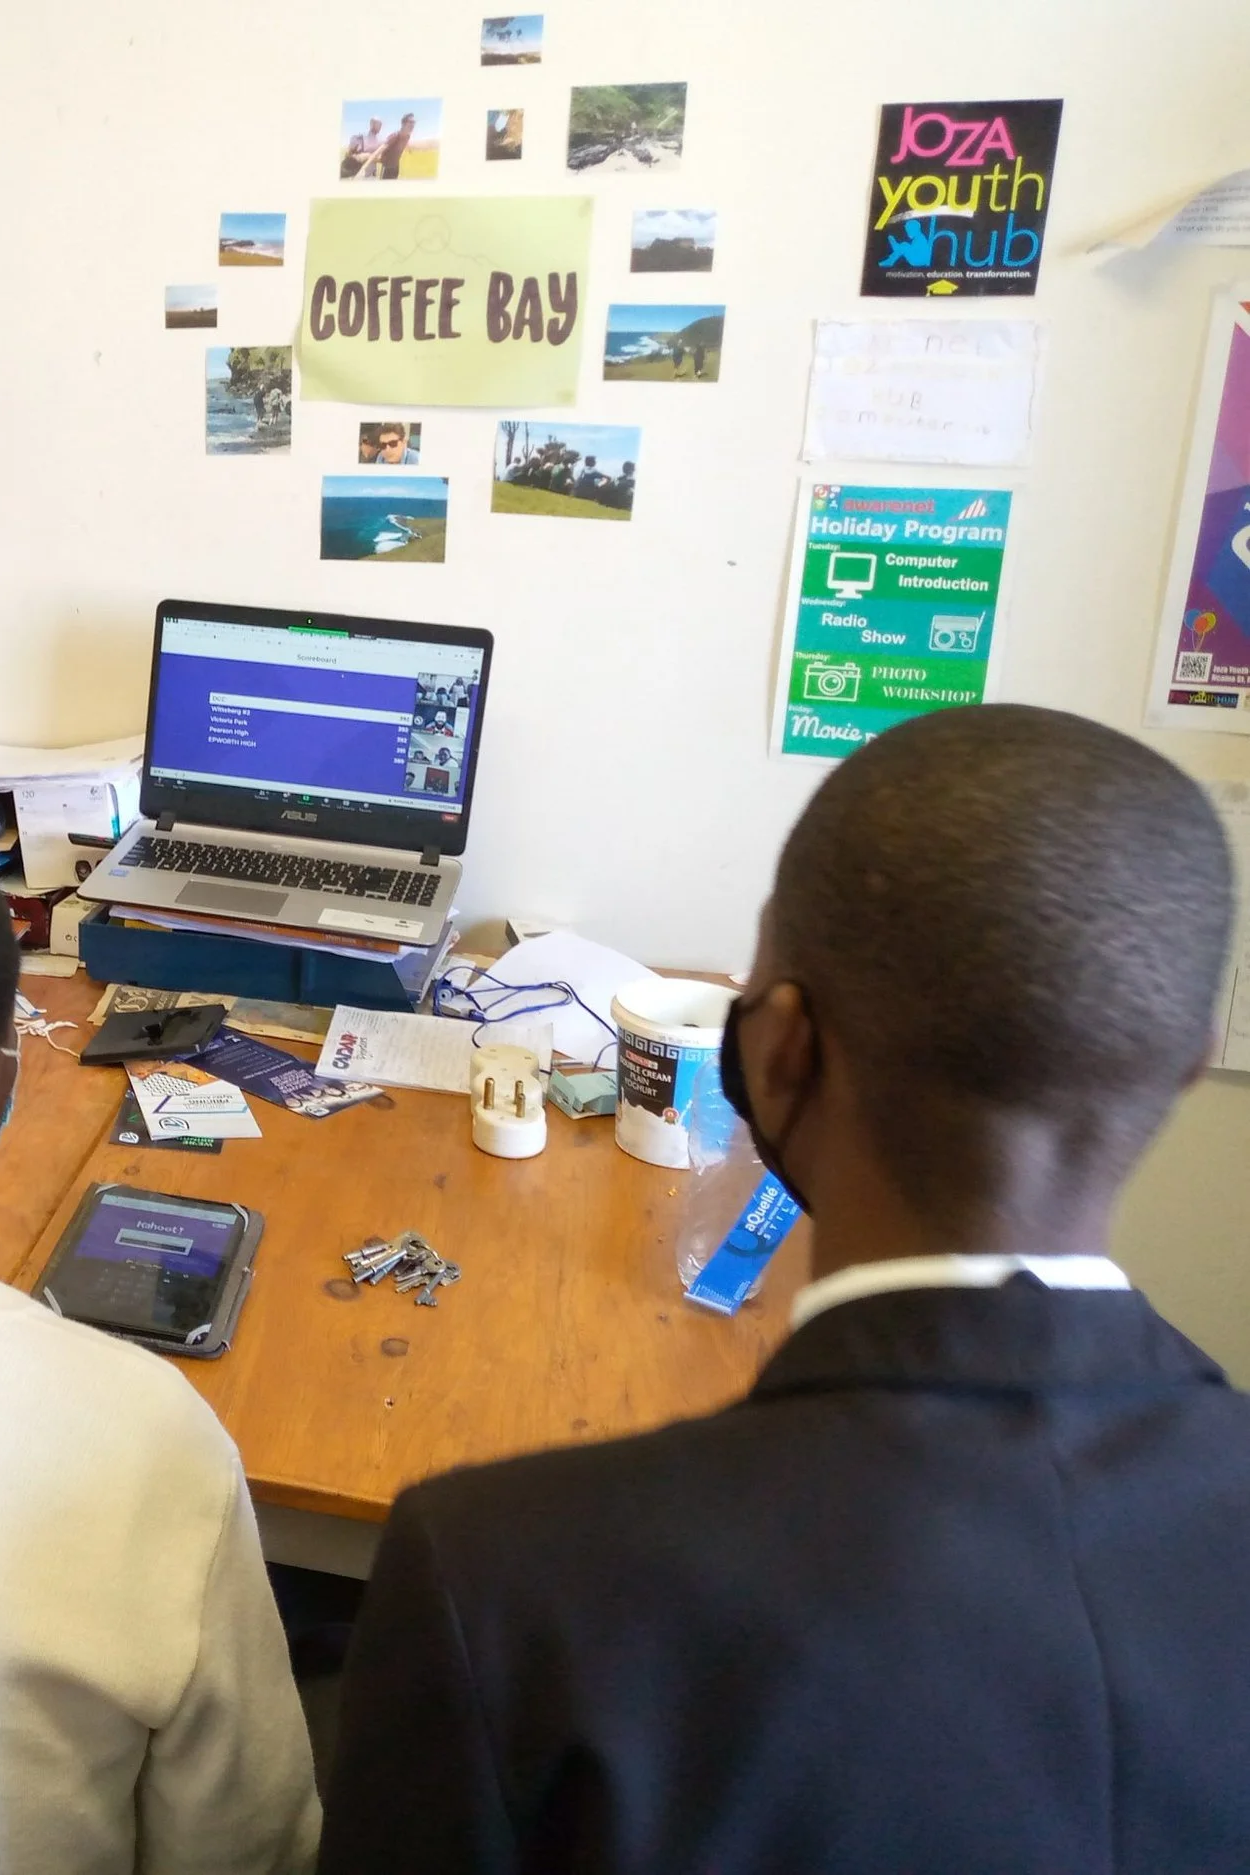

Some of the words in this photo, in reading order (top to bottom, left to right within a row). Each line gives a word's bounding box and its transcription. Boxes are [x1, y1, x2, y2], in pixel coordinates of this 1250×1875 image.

[890, 106, 1016, 167] JOZA
[874, 156, 1044, 230] youth
[928, 213, 1040, 268] hub
[310, 274, 465, 342] COFFEE
[486, 271, 578, 346] BAY
[810, 516, 898, 542] Holiday
[904, 520, 1003, 545] Program
[885, 553, 959, 570] Computer
[898, 575, 989, 592] Introduction
[822, 613, 868, 628] Radio
[861, 629, 906, 645] Show
[297, 653, 338, 665] Scoreboard
[872, 666, 928, 681] PHOTO
[882, 686, 977, 704] WORKSHOP
[792, 715, 863, 741] Movie
[280, 810, 318, 822] ASUS
[630, 1072, 650, 1086] PLAIN
[641, 1068, 672, 1083] CREAM
[744, 1185, 779, 1232] aQuellé
